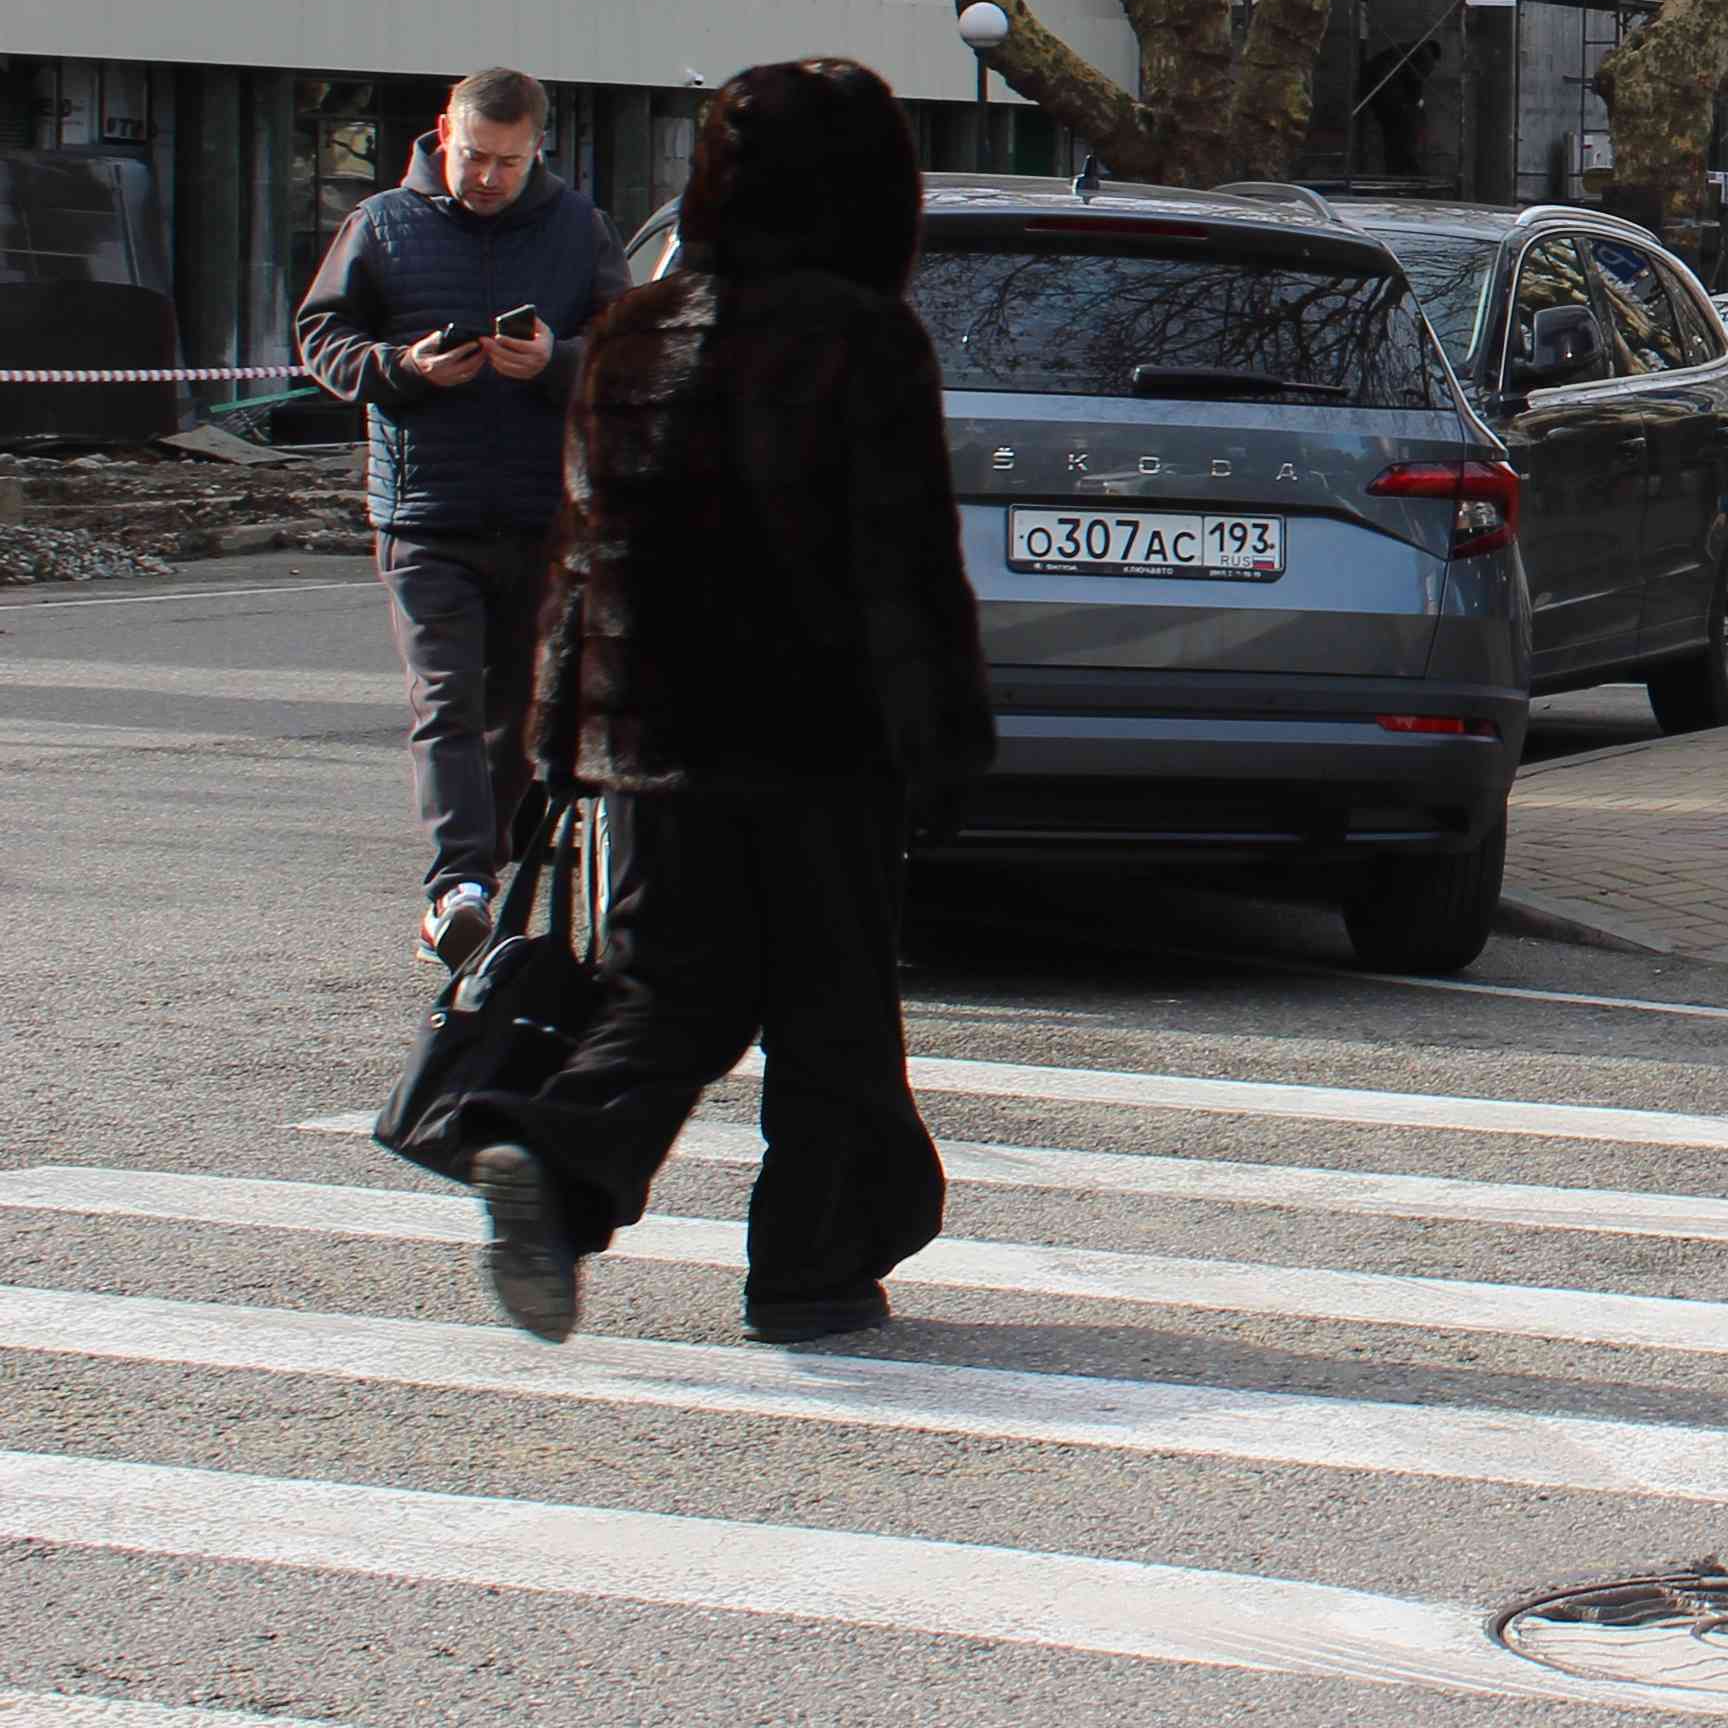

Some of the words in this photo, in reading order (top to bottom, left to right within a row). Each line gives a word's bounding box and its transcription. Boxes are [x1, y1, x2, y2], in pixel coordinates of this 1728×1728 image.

[992, 446, 1297, 482] ŠKODA
[1209, 522, 1270, 553] 193
[1220, 555, 1251, 567] RUS
